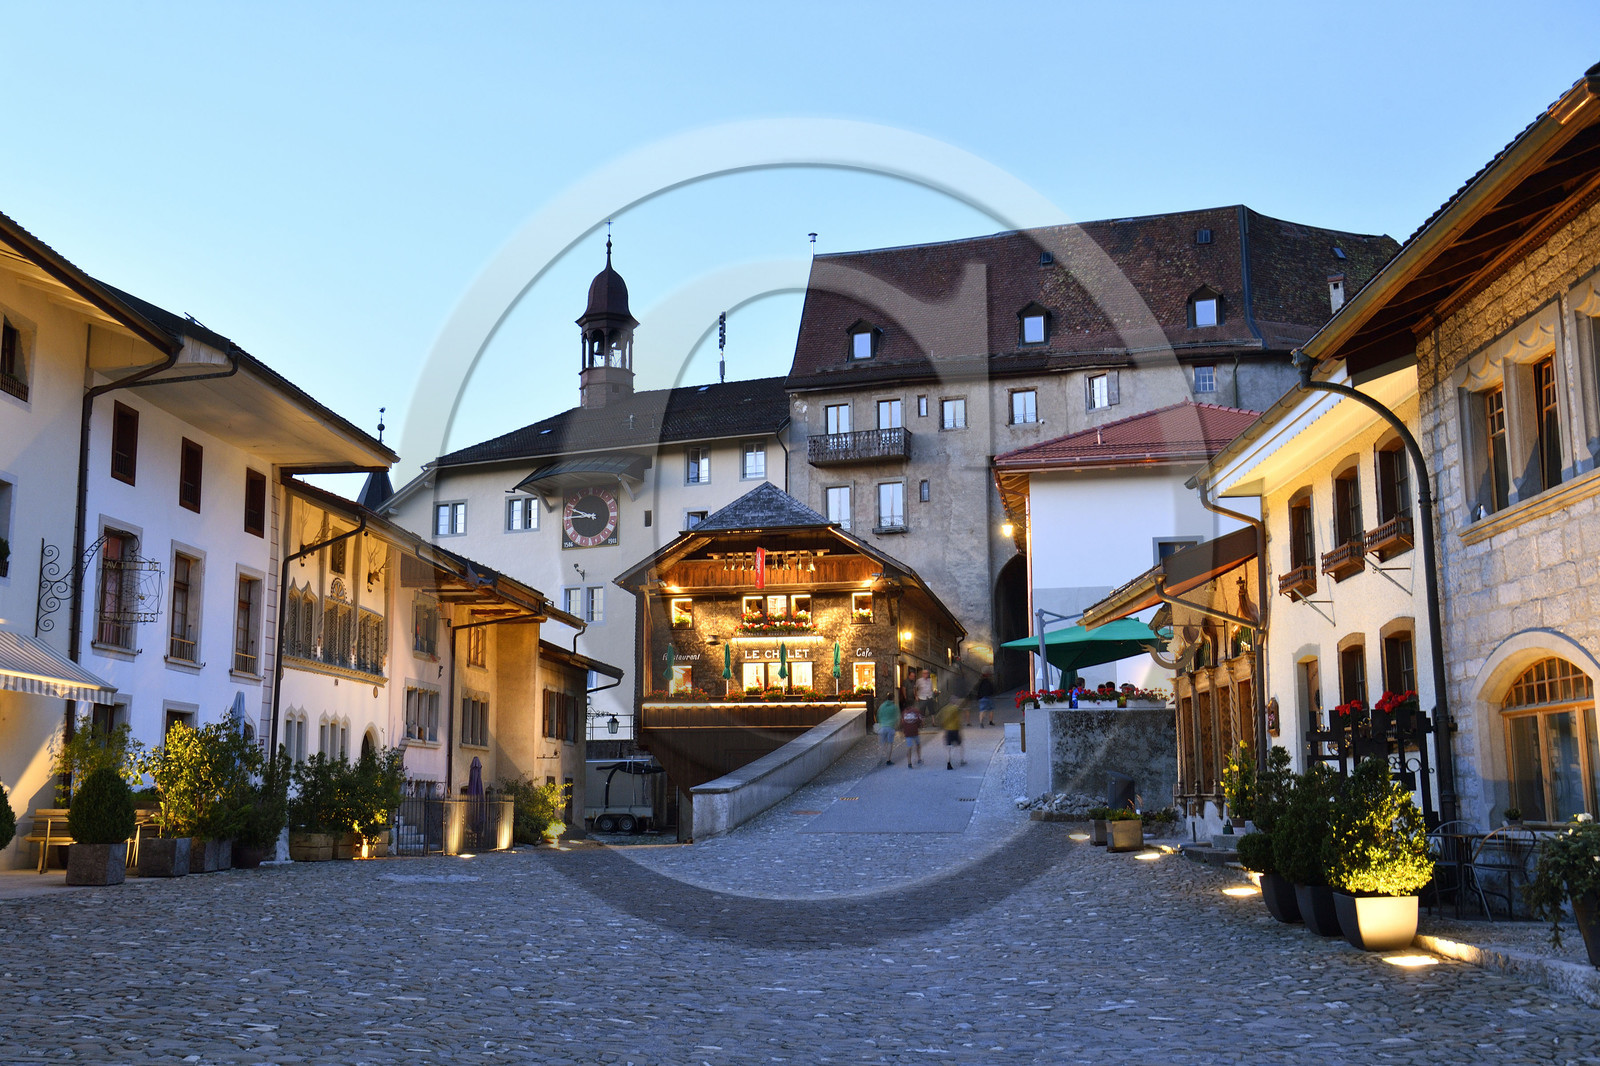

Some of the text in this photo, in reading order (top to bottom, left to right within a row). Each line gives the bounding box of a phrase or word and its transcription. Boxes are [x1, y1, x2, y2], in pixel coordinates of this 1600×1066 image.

[662, 653, 701, 661] Rtaurant
[744, 649, 810, 659] LE CHLET
